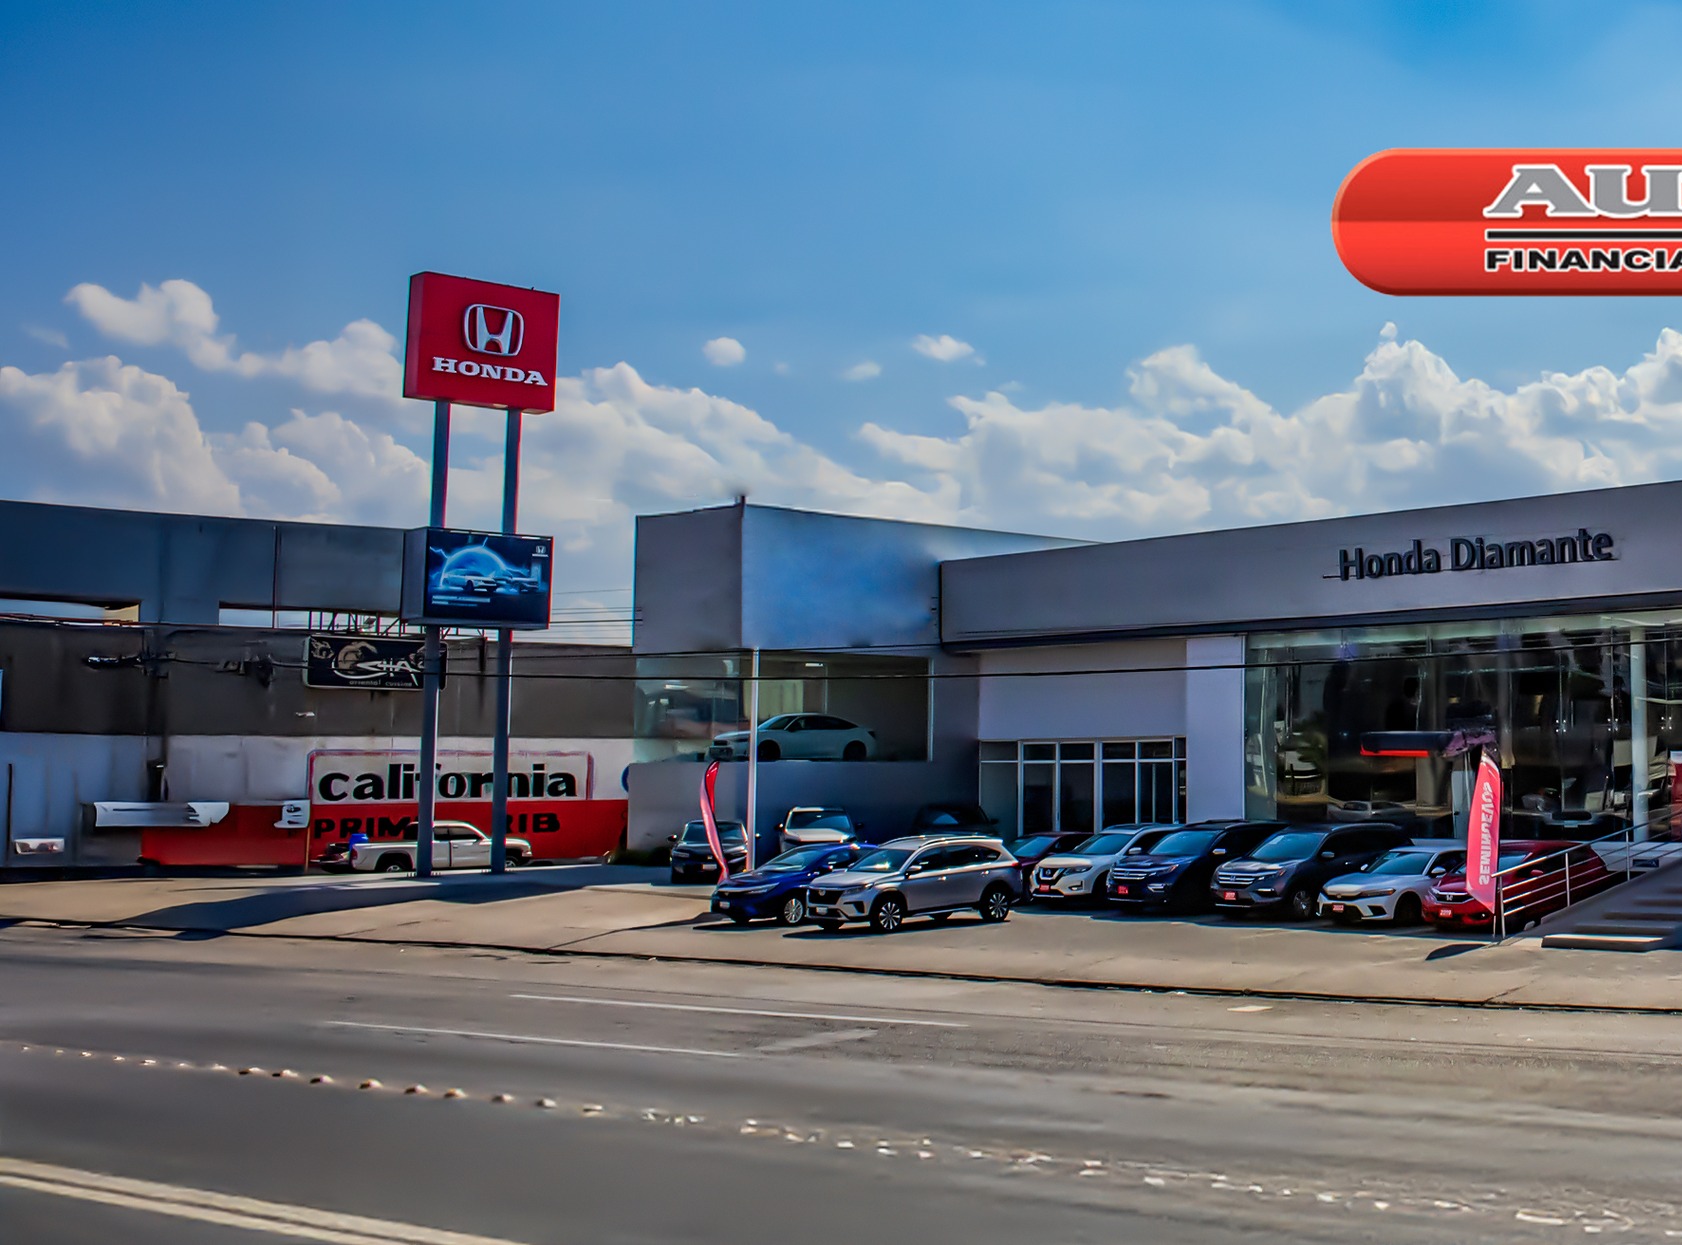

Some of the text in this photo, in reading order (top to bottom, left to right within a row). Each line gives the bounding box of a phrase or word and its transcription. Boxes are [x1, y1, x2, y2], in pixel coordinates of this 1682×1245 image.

[432, 356, 549, 387] HONDA
[1339, 528, 1614, 580] Honda Diamante
[314, 815, 420, 839] PRIM
